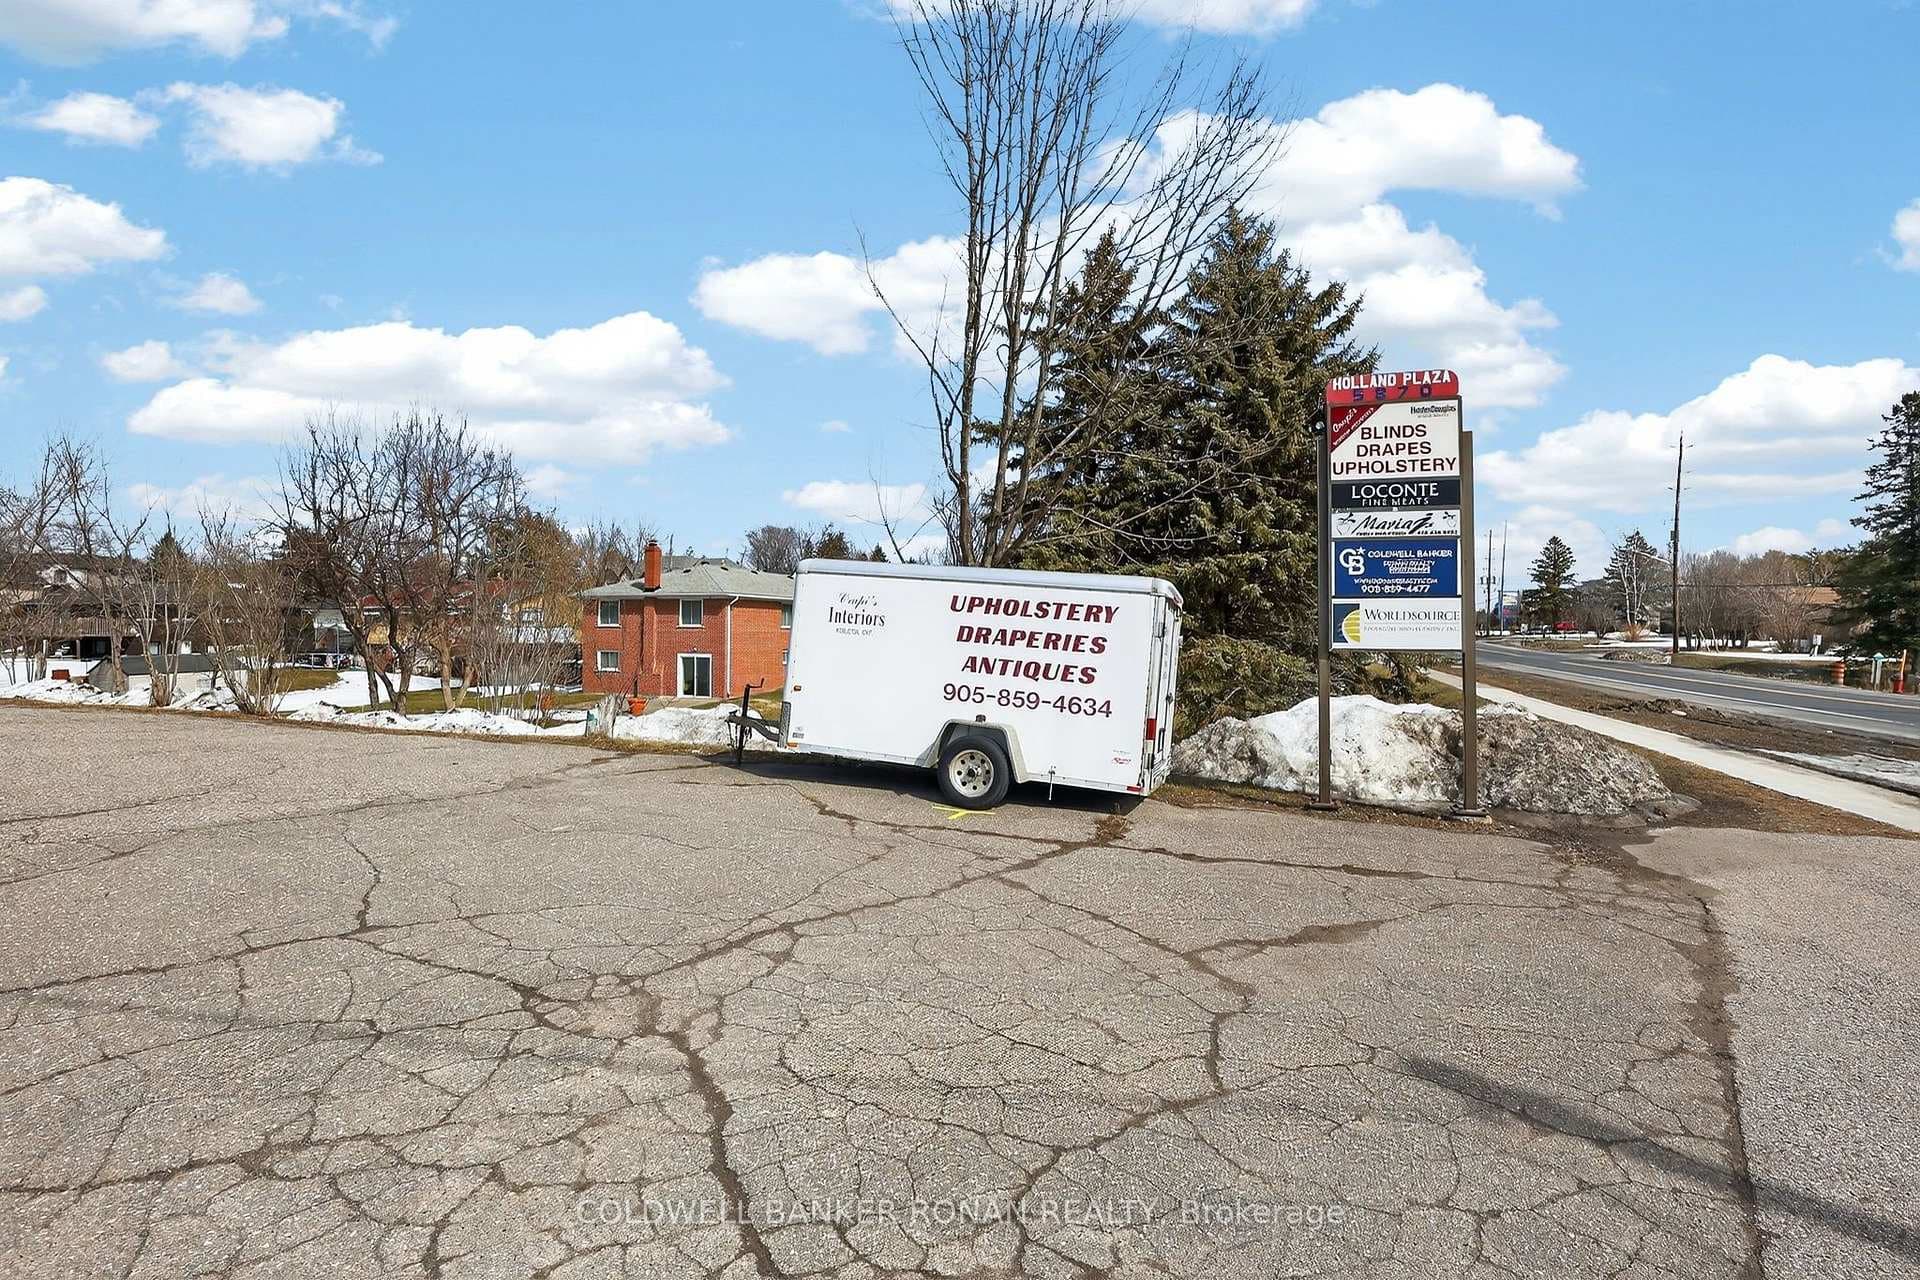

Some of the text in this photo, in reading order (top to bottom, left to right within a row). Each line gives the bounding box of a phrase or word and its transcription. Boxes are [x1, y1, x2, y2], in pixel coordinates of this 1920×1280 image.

[1332, 370, 1451, 390] HOLLAND PLAZA
[1360, 424, 1427, 440] BLINDS
[1356, 441, 1432, 457] DRAPES
[1332, 457, 1457, 475] UPHOLSTERY
[1351, 482, 1439, 499] LOCONTE
[1362, 497, 1429, 507] FINE MEATS
[1416, 549, 1453, 558] BANKER
[829, 606, 886, 627] Interiors
[950, 595, 1120, 624] UPHOLSTERY
[956, 625, 1108, 654] DRAPERIES
[961, 655, 1098, 685] ANTIQUES
[943, 683, 1113, 718] 905-859-4634
